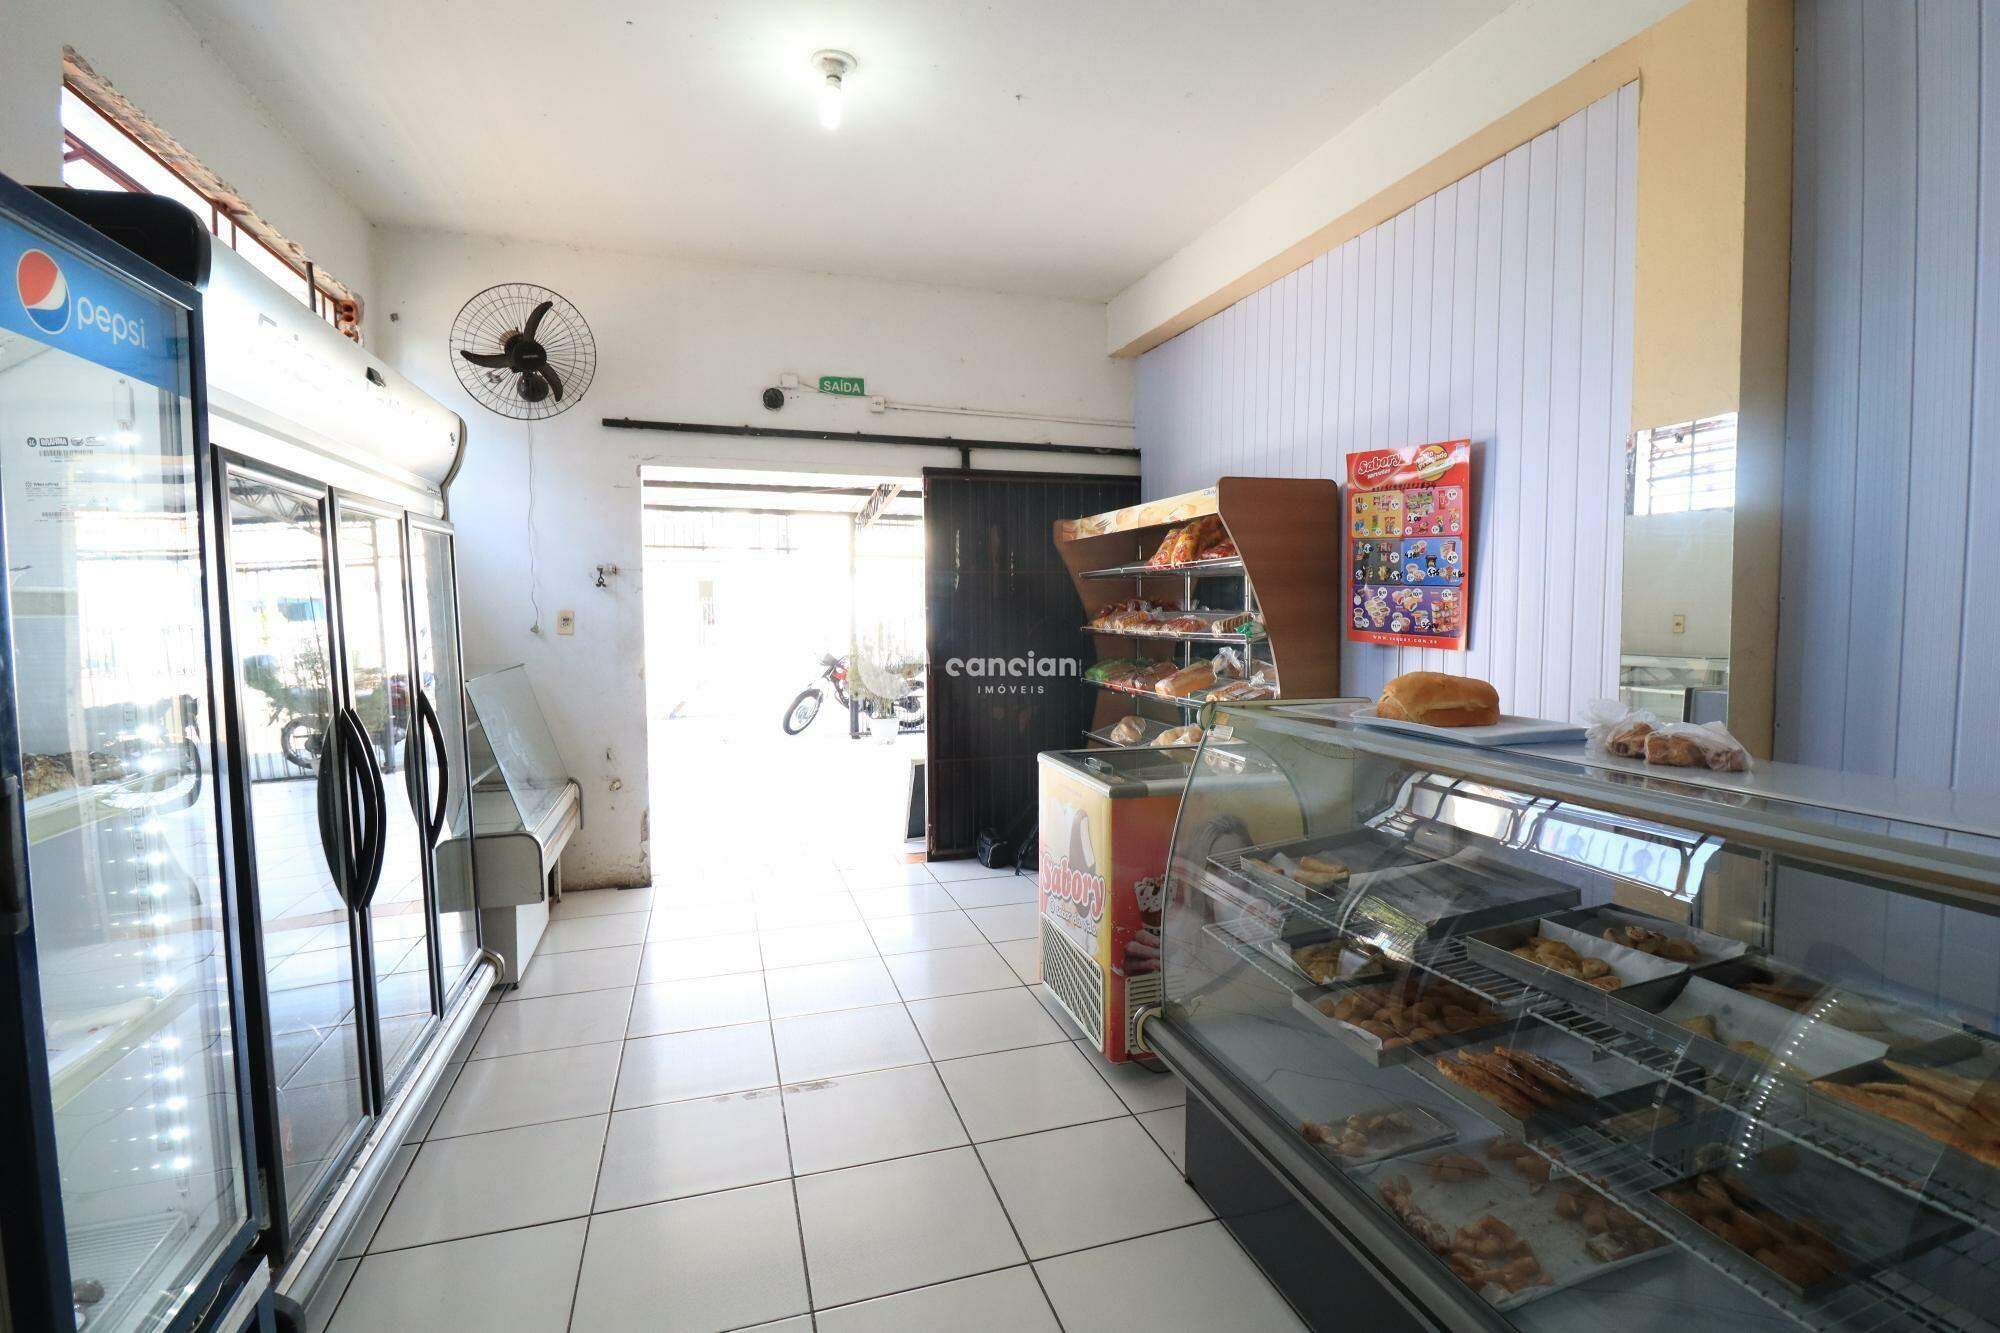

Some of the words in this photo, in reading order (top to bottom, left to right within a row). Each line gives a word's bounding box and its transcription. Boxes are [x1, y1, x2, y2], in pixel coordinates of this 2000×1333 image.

[77, 296, 146, 350] pepsi
[823, 380, 861, 393] SAÍDA
[1358, 453, 1401, 475] Sabory
[1042, 853, 1106, 924] Sabory
